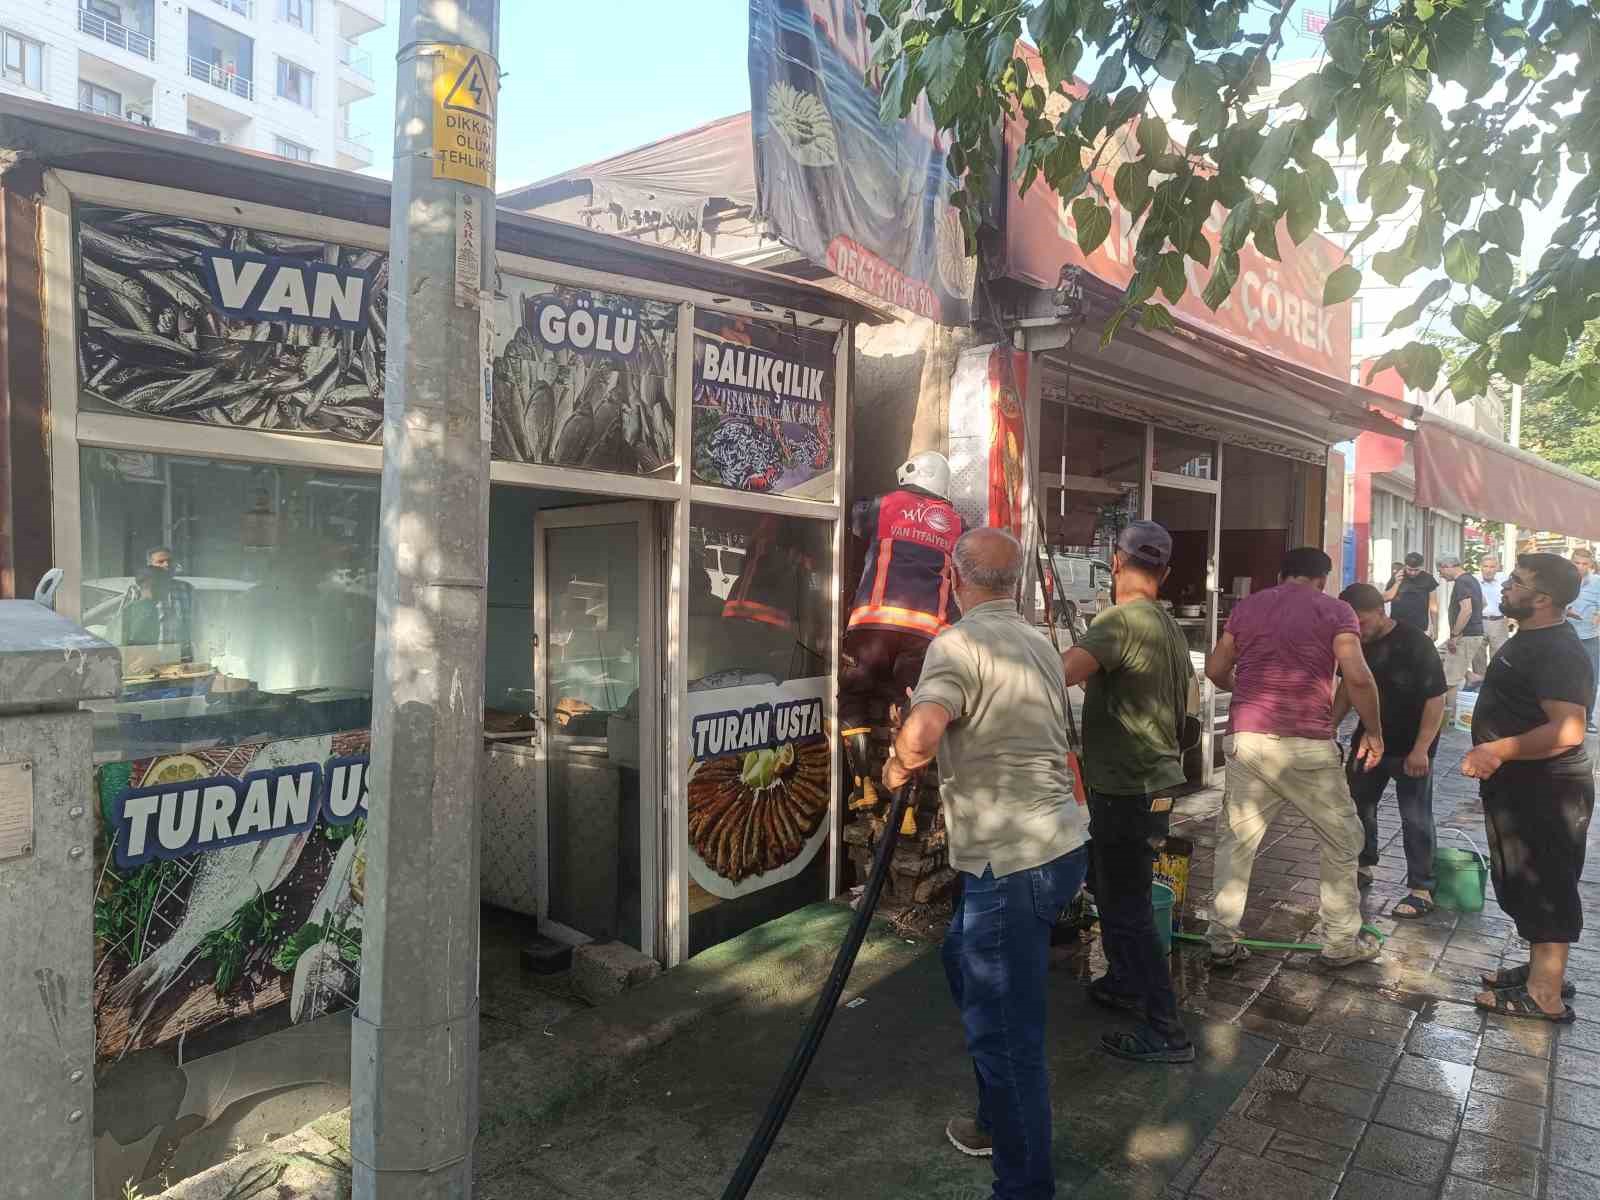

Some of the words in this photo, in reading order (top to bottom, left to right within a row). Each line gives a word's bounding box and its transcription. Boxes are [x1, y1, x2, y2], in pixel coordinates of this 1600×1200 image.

[211, 256, 364, 323] VAN
[1241, 268, 1334, 358] ÇÖREK
[539, 299, 637, 355] GÖLÜ
[702, 343, 825, 404] BALIKÇILIK
[696, 709, 769, 758] TURAN
[775, 702, 821, 740] USTA
[123, 771, 313, 857] TURAN
